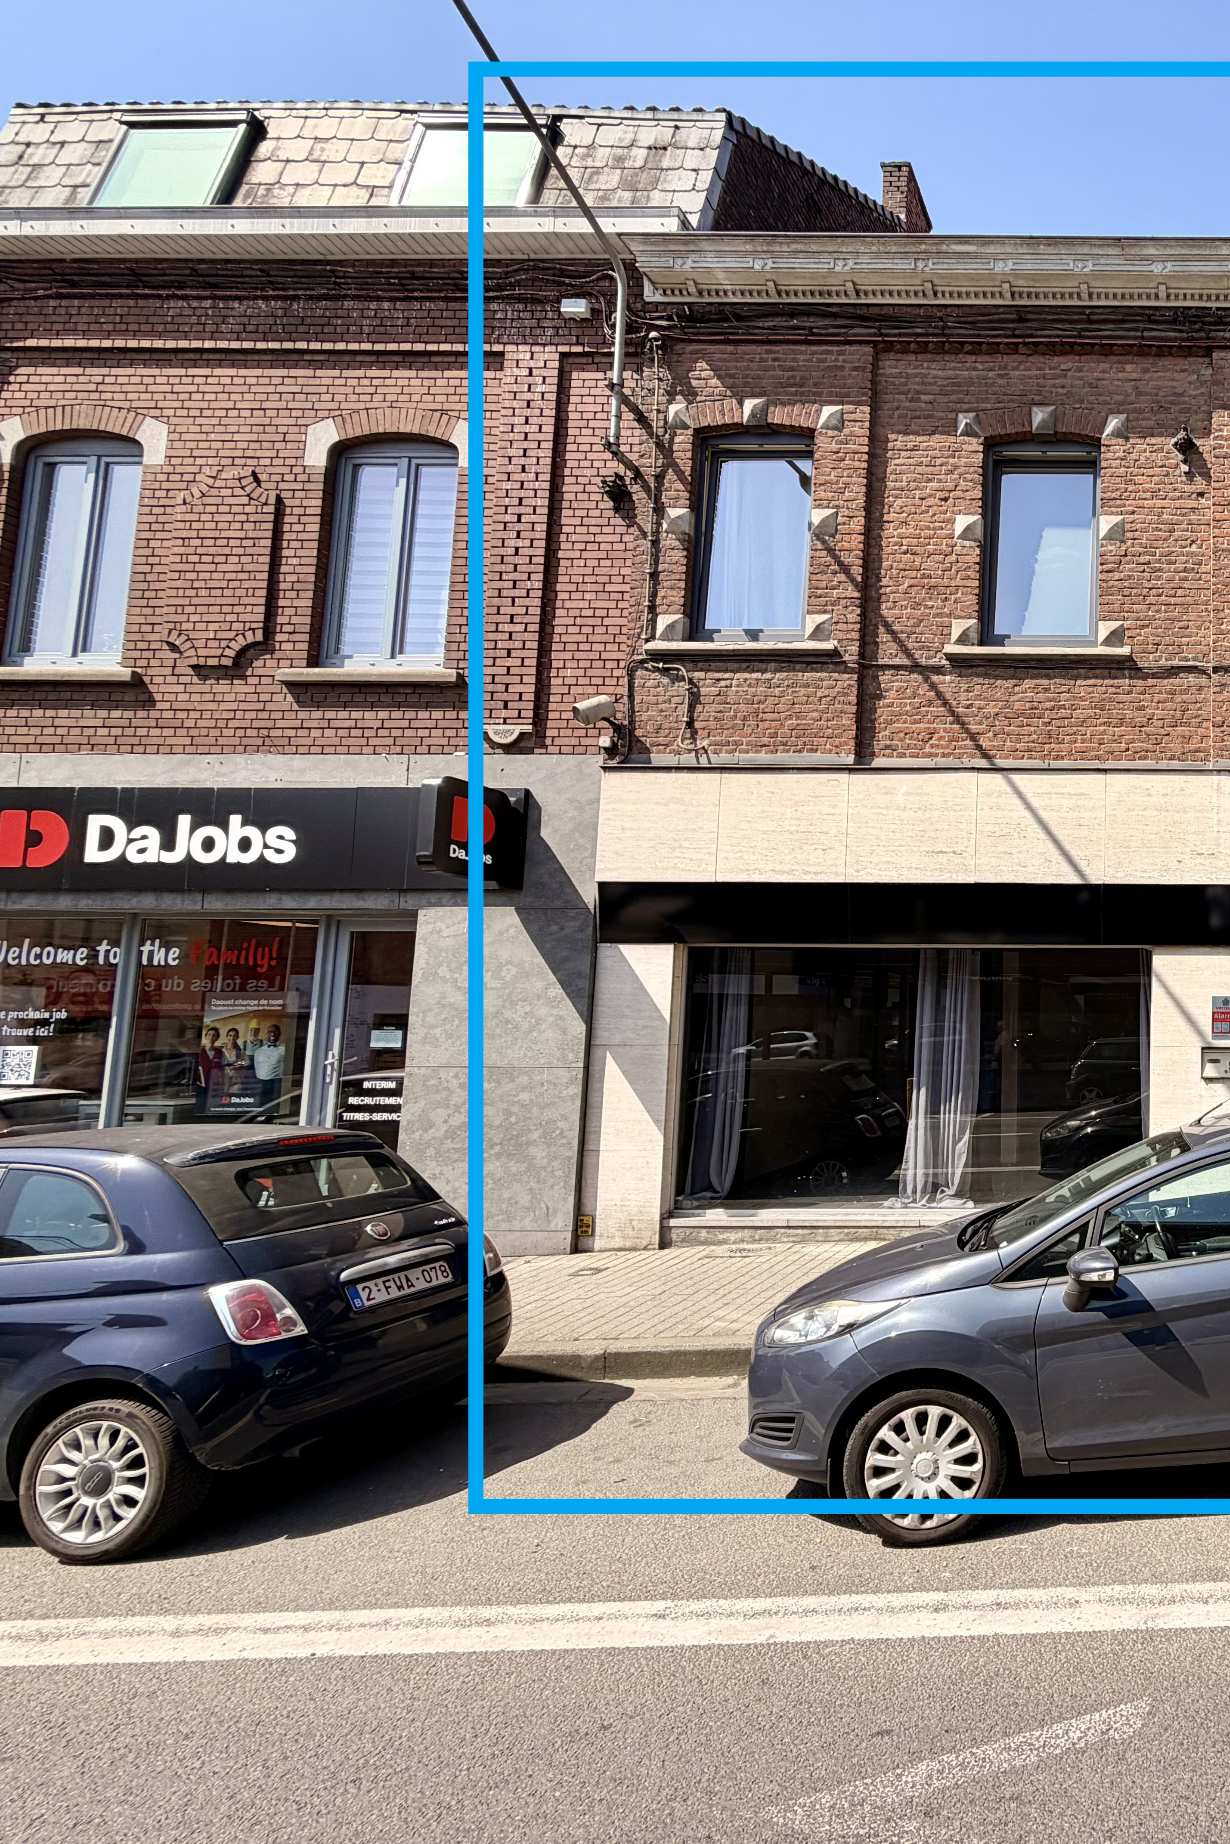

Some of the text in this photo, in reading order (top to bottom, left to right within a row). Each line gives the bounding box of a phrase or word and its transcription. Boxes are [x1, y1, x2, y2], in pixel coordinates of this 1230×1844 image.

[83, 814, 297, 864] DaJobs
[96, 939, 120, 965] to
[140, 938, 181, 966] the
[7, 1008, 50, 1021] prochain
[50, 1008, 67, 1022] job
[2, 1023, 54, 1037] trouve ici!
[363, 1080, 396, 1089] INTERIM
